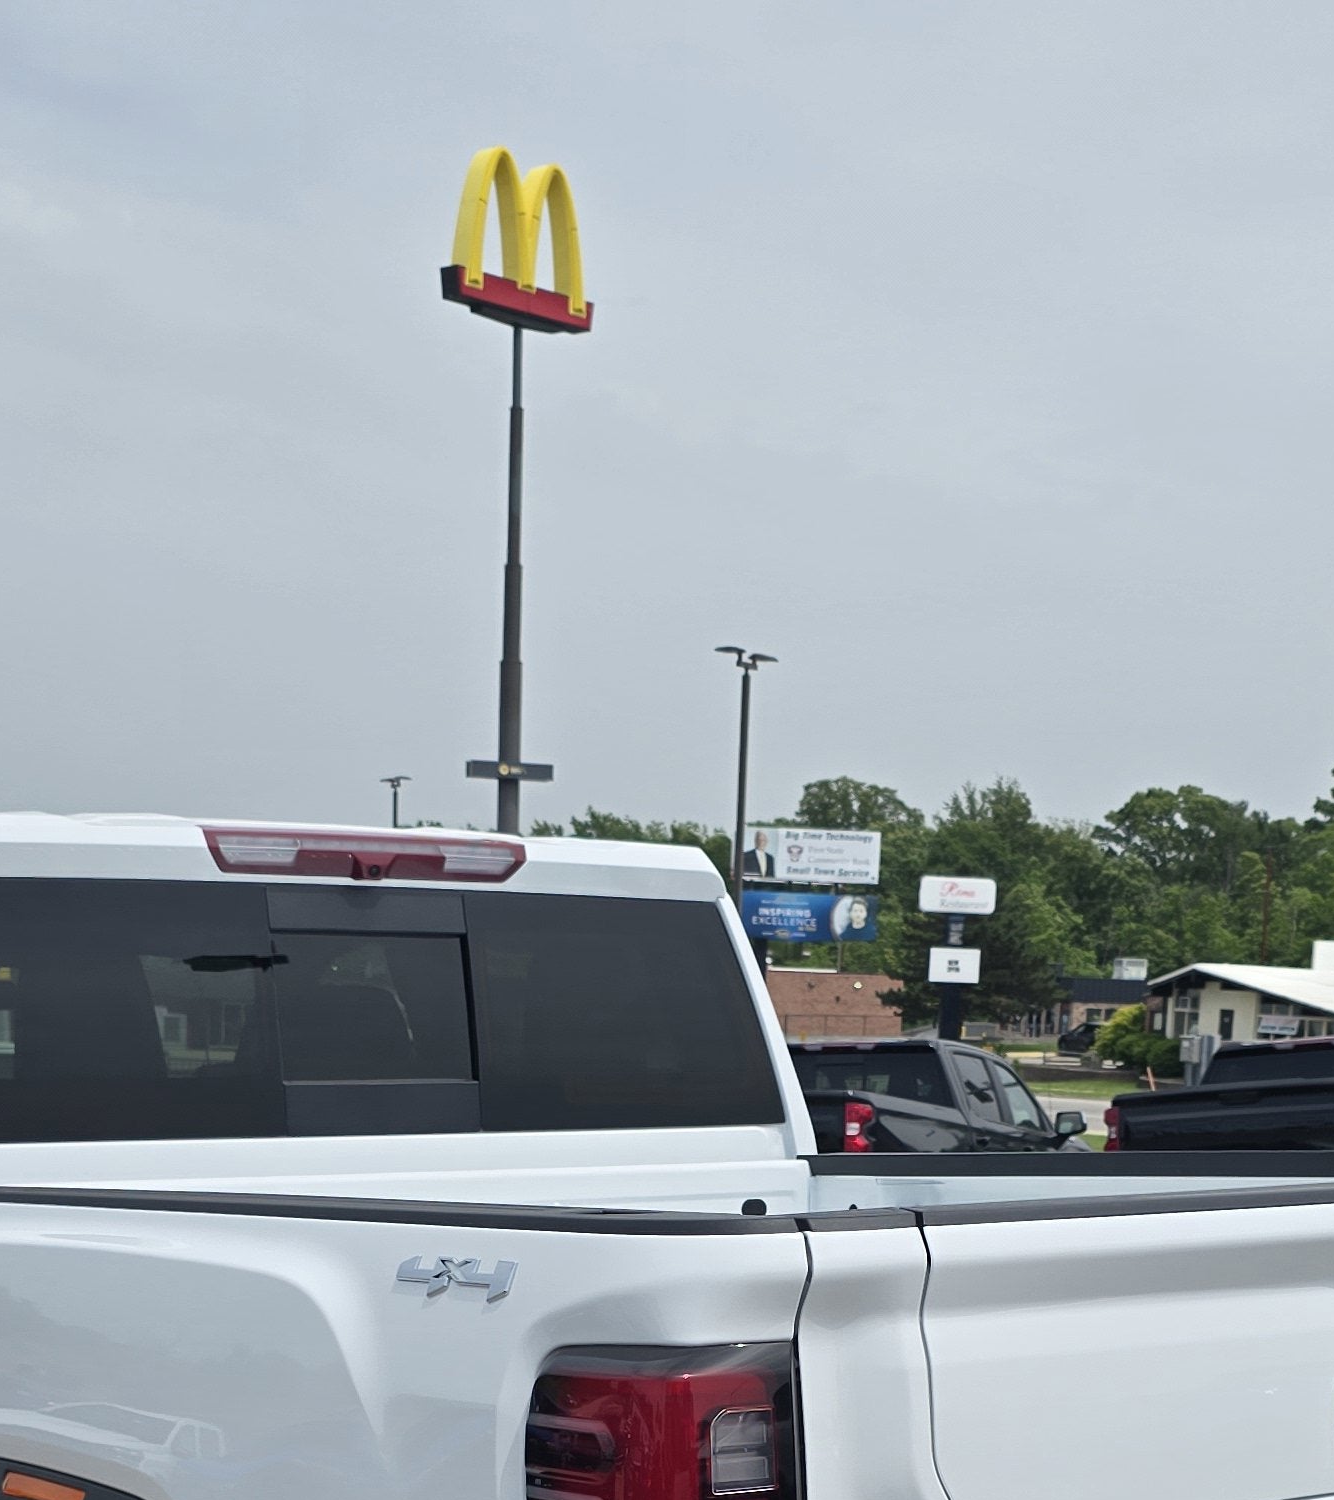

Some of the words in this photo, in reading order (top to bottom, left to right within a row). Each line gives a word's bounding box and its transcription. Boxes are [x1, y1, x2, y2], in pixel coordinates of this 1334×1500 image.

[785, 831, 800, 841] Big
[803, 832, 823, 840] Time
[826, 832, 874, 844] Technology
[786, 866, 811, 875] Small
[814, 867, 836, 876] Town
[838, 868, 869, 877] Service
[759, 907, 812, 918] INSPIRING
[752, 916, 817, 927] EXCELLENCE
